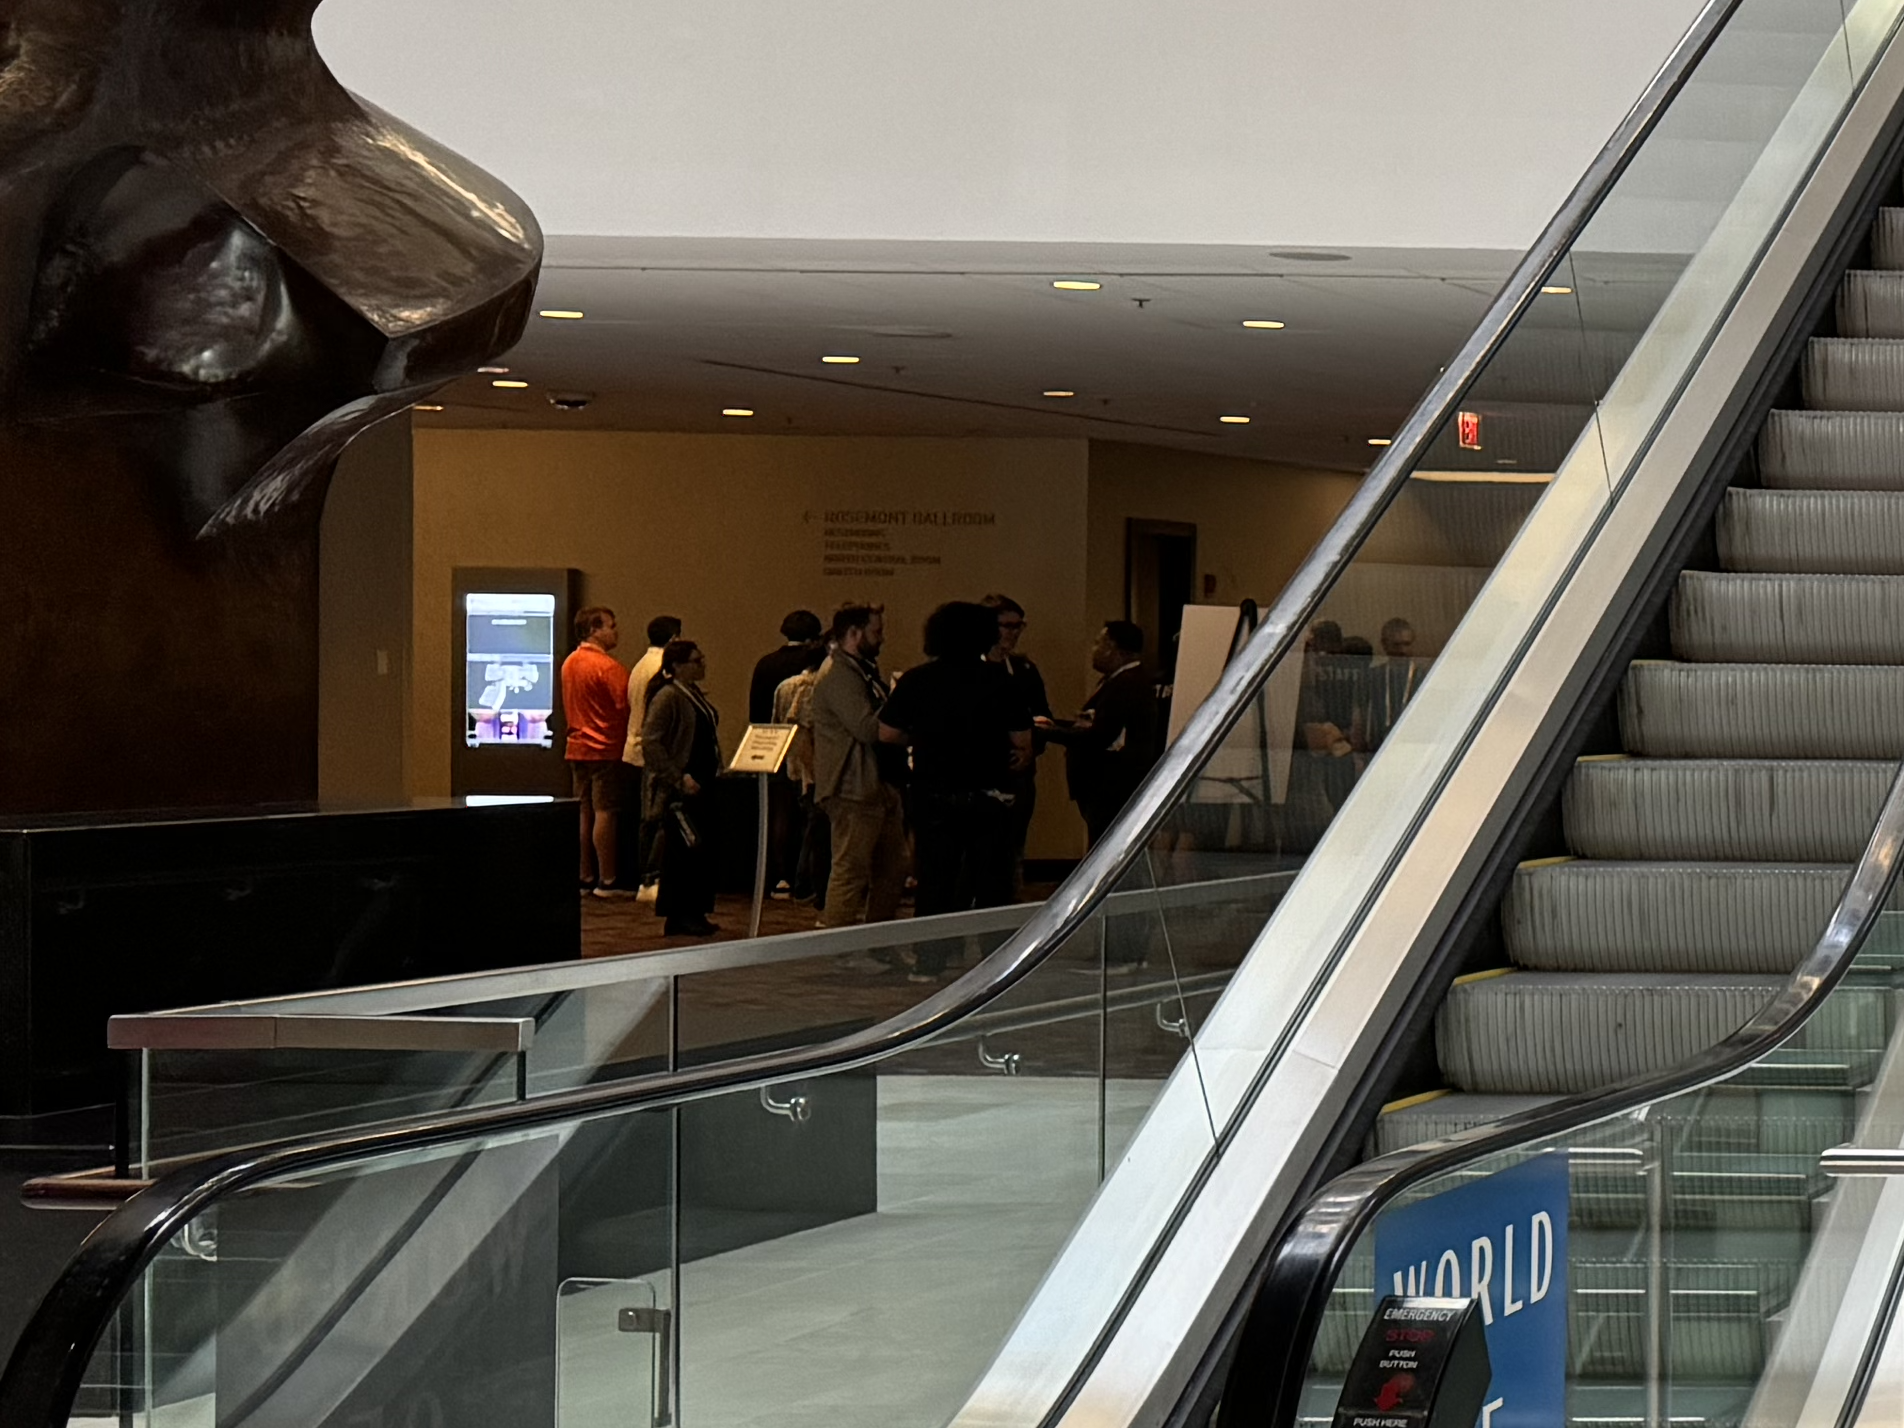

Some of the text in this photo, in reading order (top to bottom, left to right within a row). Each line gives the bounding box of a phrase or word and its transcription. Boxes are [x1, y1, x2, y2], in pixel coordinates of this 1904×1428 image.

[1384, 1309, 1455, 1321] EMERGENCY
[1385, 1329, 1436, 1343] STOP
[1388, 1349, 1416, 1358] PUSH
[1379, 1360, 1418, 1368] BUTTON
[1353, 1418, 1408, 1428] PUSH HERE
